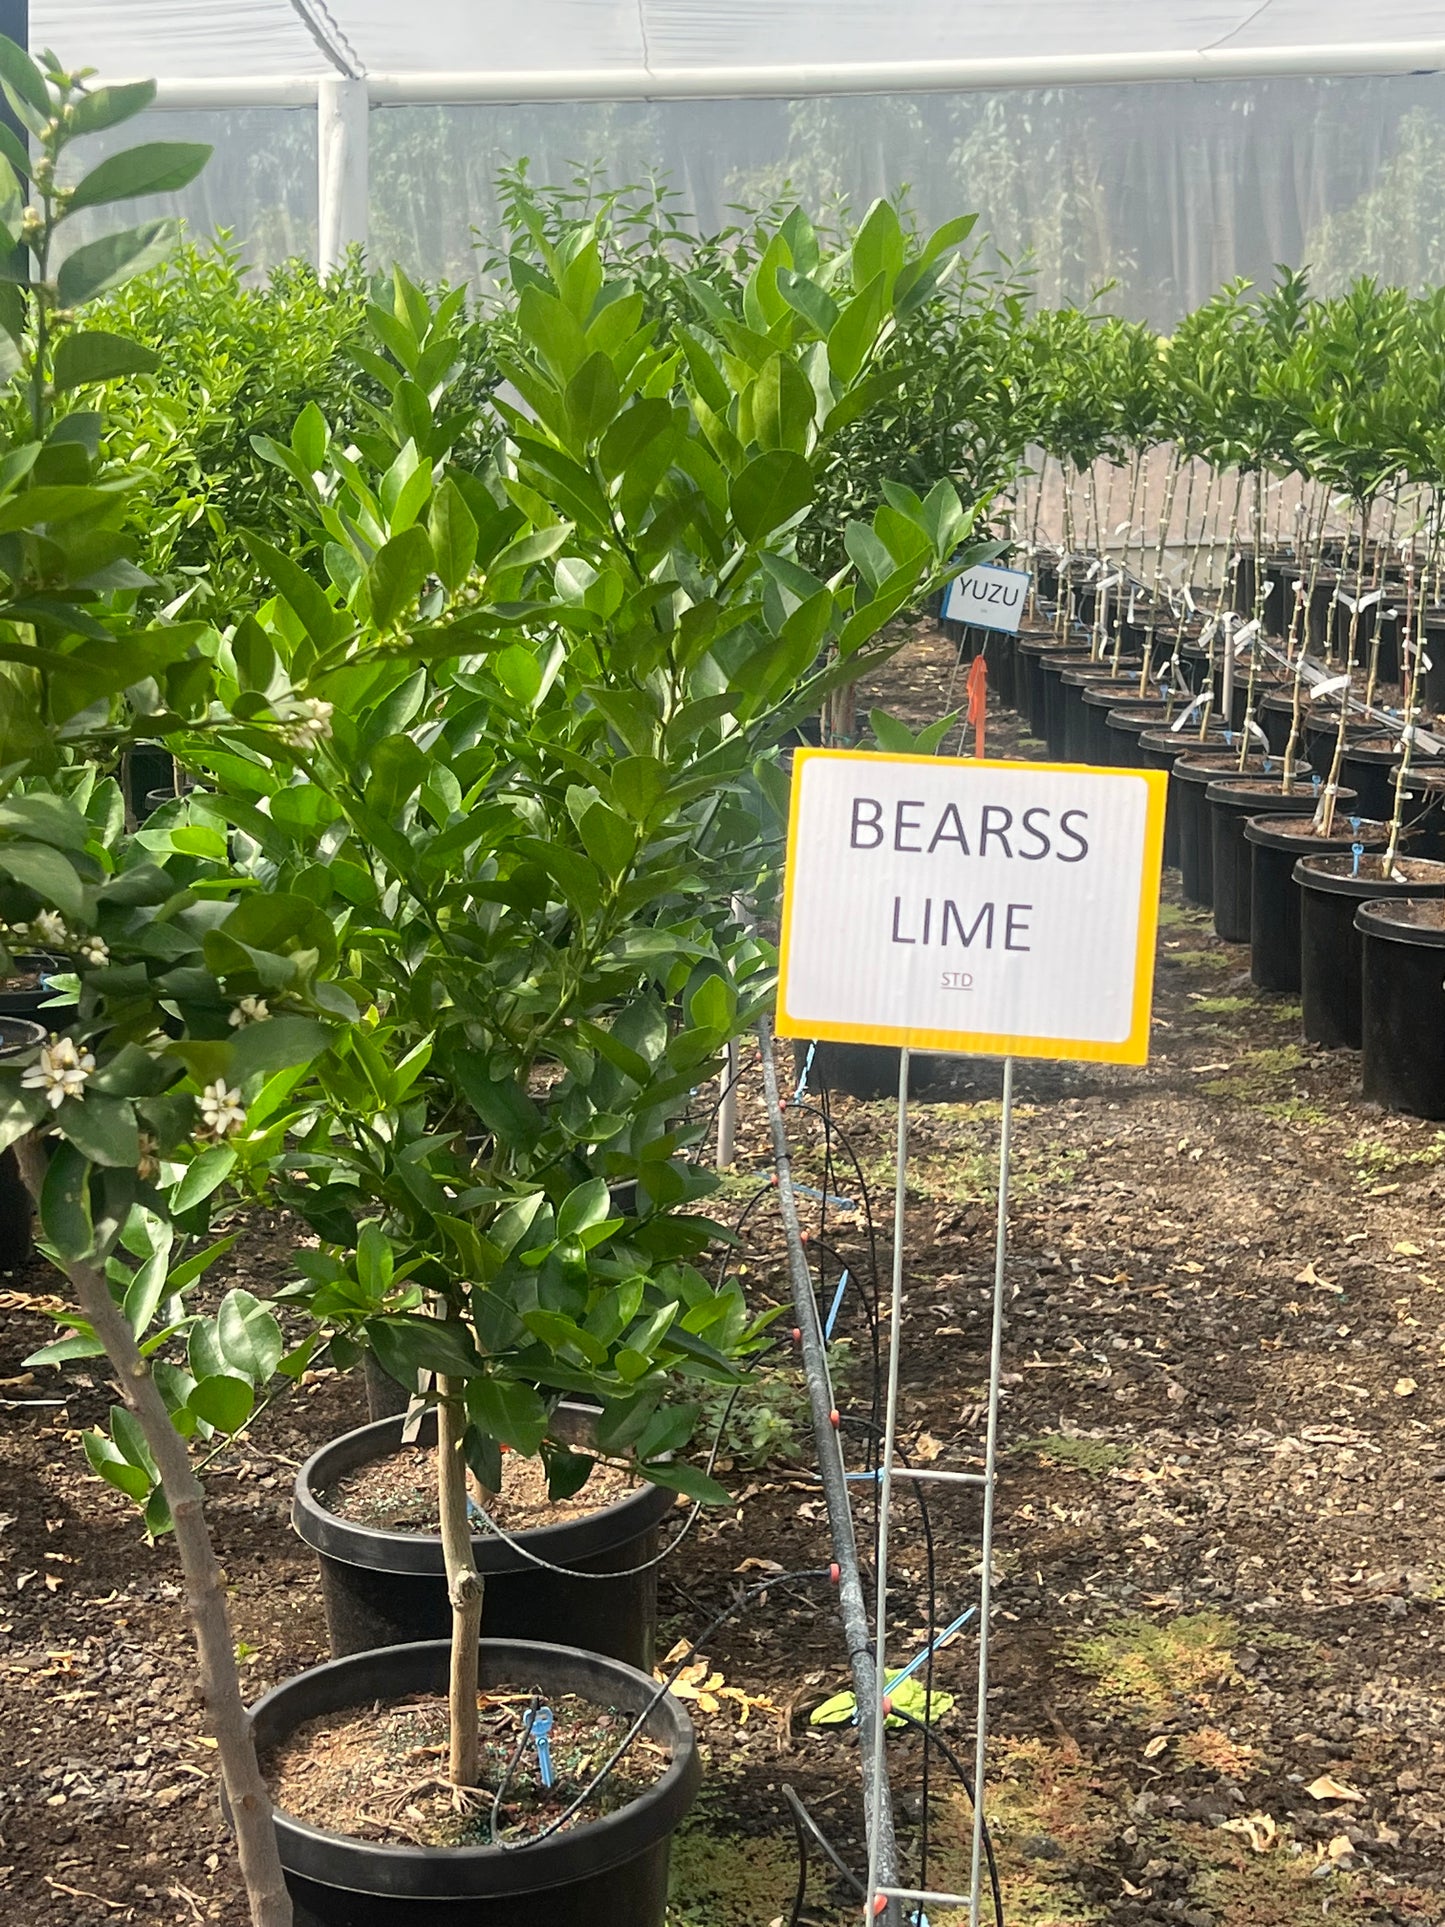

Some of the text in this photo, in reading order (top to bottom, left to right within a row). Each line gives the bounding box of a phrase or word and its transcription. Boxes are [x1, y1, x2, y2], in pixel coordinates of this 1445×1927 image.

[960, 577, 1019, 607] YUZU
[849, 798, 1090, 863] BEARSS
[891, 896, 1033, 952] LIME
[940, 972, 974, 990] STD
